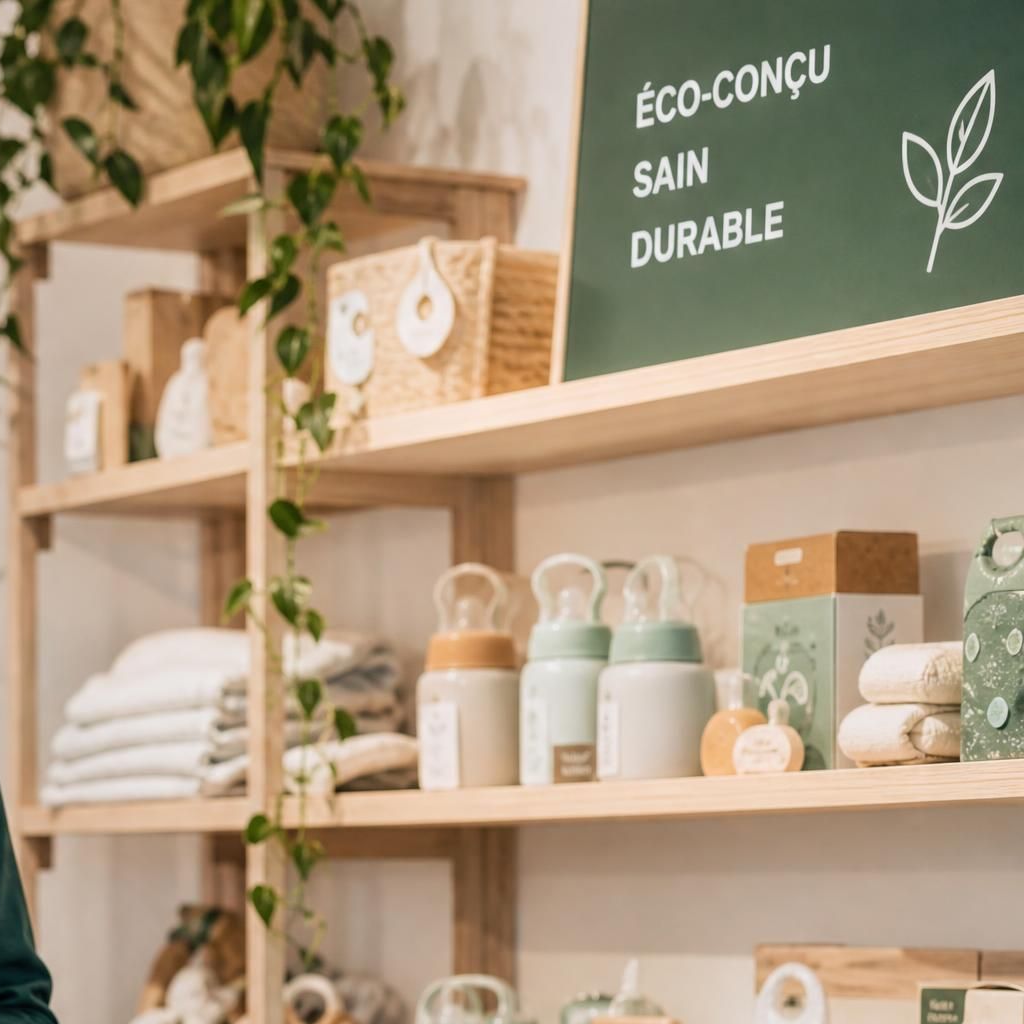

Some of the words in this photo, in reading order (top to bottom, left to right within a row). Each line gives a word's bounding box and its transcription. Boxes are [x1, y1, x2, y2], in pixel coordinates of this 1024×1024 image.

[636, 45, 831, 128] ÉCO-CONÇU
[632, 147, 709, 198] SAIN
[630, 201, 784, 268] DURABLE
